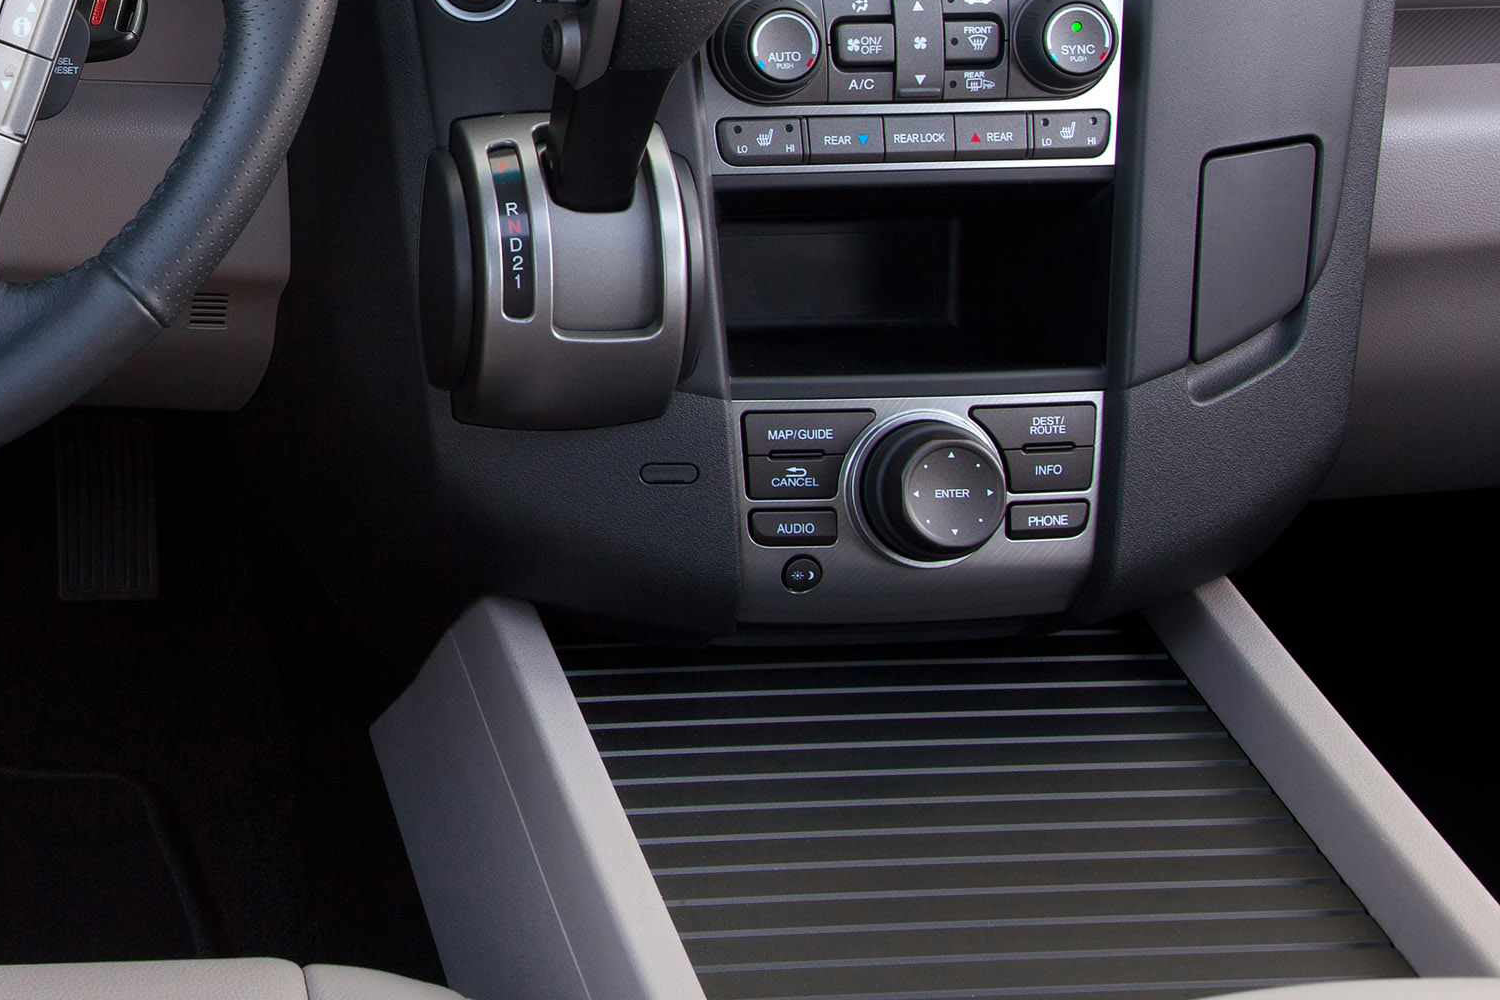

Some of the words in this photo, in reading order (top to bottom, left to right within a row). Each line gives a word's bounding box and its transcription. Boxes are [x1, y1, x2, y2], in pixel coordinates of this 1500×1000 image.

[964, 26, 992, 34] FRONT
[860, 36, 882, 45] ON/
[860, 46, 882, 55] OFF
[1061, 44, 1095, 55] SYNC
[57, 58, 74, 66] SEL
[768, 51, 801, 62] AUTO
[848, 78, 875, 90] A/C
[824, 135, 851, 146] REAR
[893, 133, 919, 144] REAR
[920, 132, 945, 143] LOCK
[987, 132, 1013, 142] REAR
[1042, 138, 1052, 146] LO
[1087, 137, 1096, 146] HI
[737, 145, 748, 154] LO
[785, 144, 795, 152] HI
[498, 161, 509, 173] P
[505, 202, 518, 217] R
[507, 219, 521, 234] N
[510, 238, 522, 253] D
[512, 256, 523, 271] 2
[514, 274, 521, 289] 1
[1032, 416, 1065, 427] DEST/
[767, 428, 834, 441] MAP/GUIDE
[1029, 425, 1066, 435] ROUTE
[1035, 464, 1063, 476] INFO
[771, 476, 820, 488] CANCEL
[934, 488, 970, 499] ENTER
[1027, 515, 1068, 527] PHONE
[776, 522, 815, 534] AUDIO
